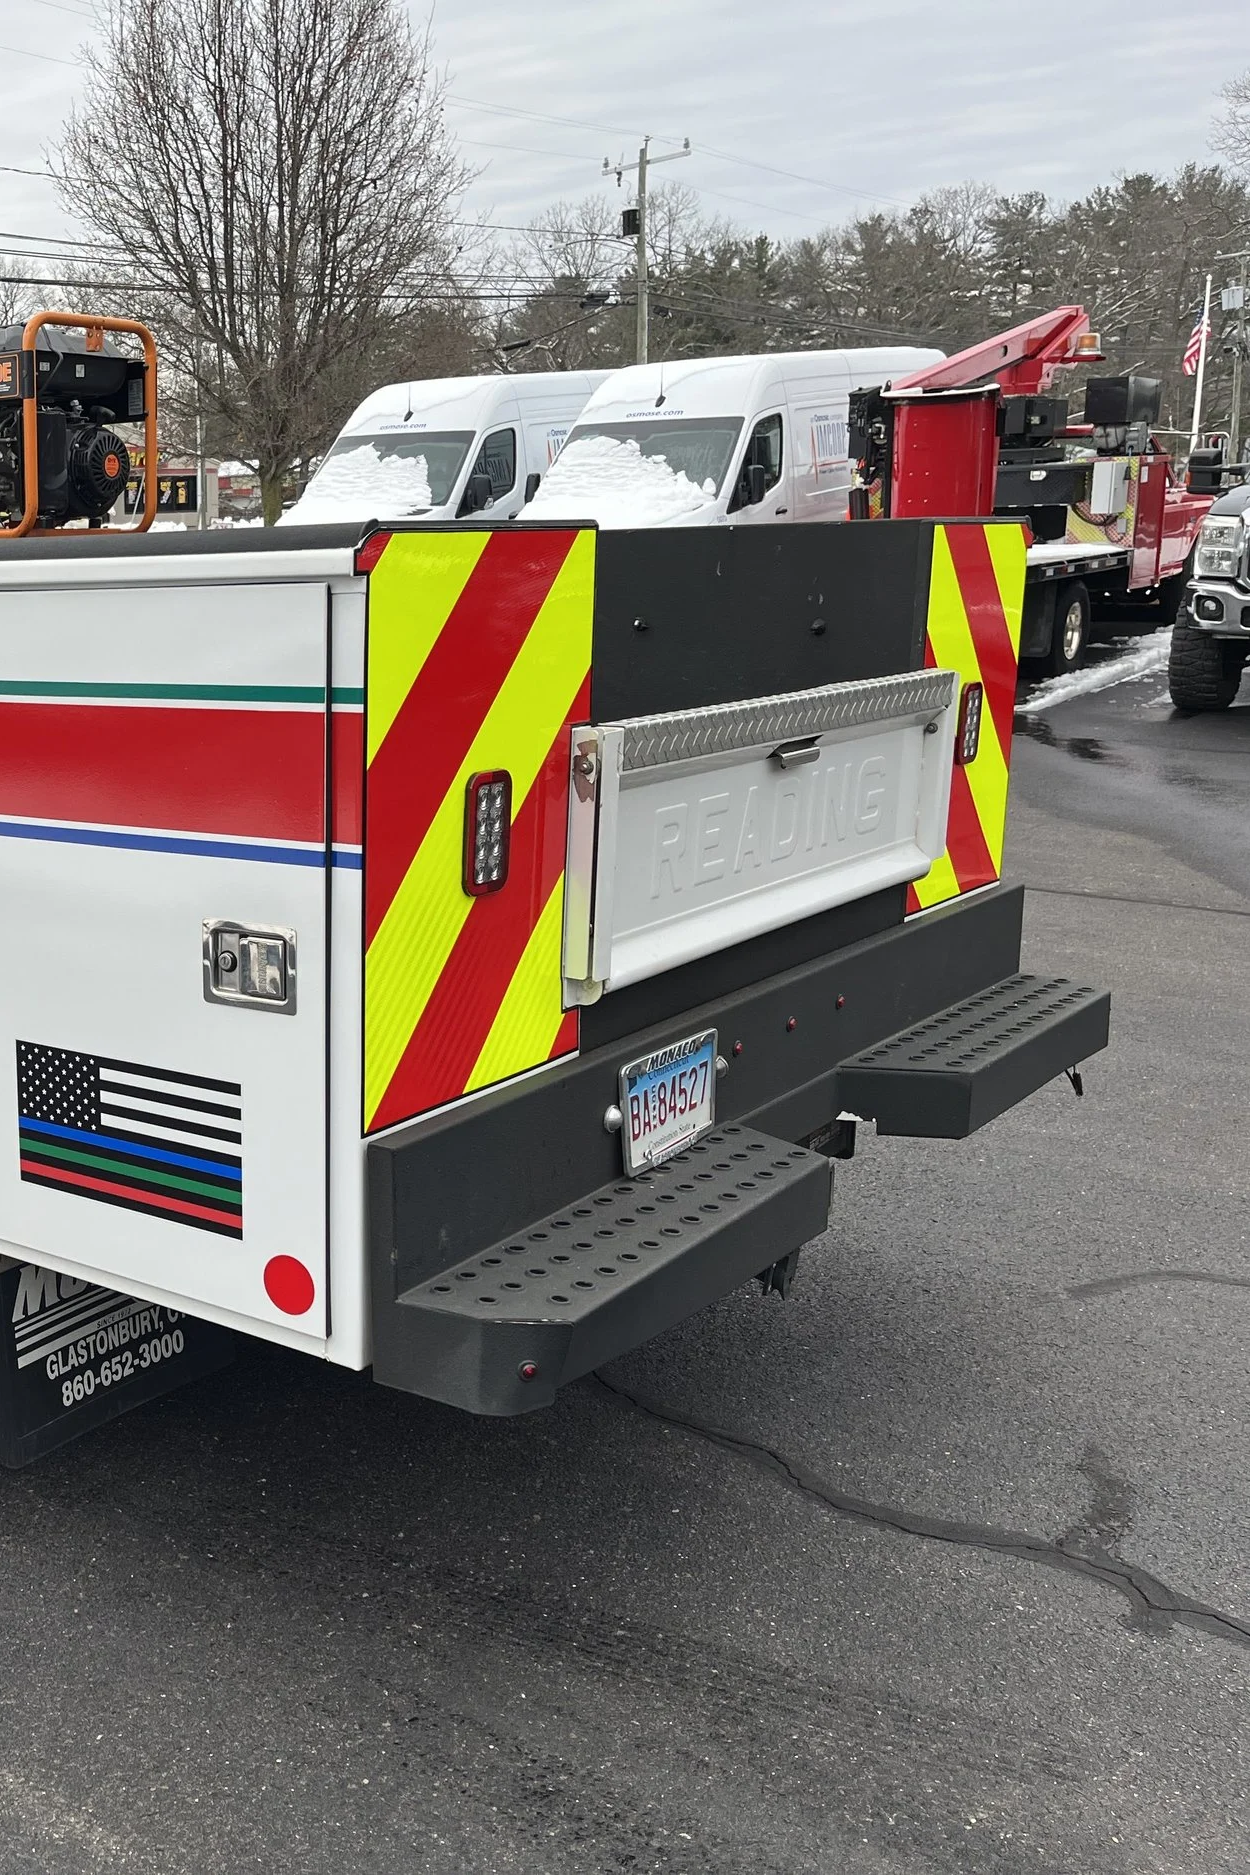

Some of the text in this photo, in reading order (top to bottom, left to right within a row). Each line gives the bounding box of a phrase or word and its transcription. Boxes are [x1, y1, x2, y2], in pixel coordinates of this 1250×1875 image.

[379, 422, 427, 431] osmose.com
[626, 409, 684, 418] osmose.com
[652, 755, 886, 900] READING
[646, 1040, 698, 1073] MONACO
[46, 1305, 165, 1380] GLASTONBURY,
[61, 1329, 185, 1407] 860-652-3000
